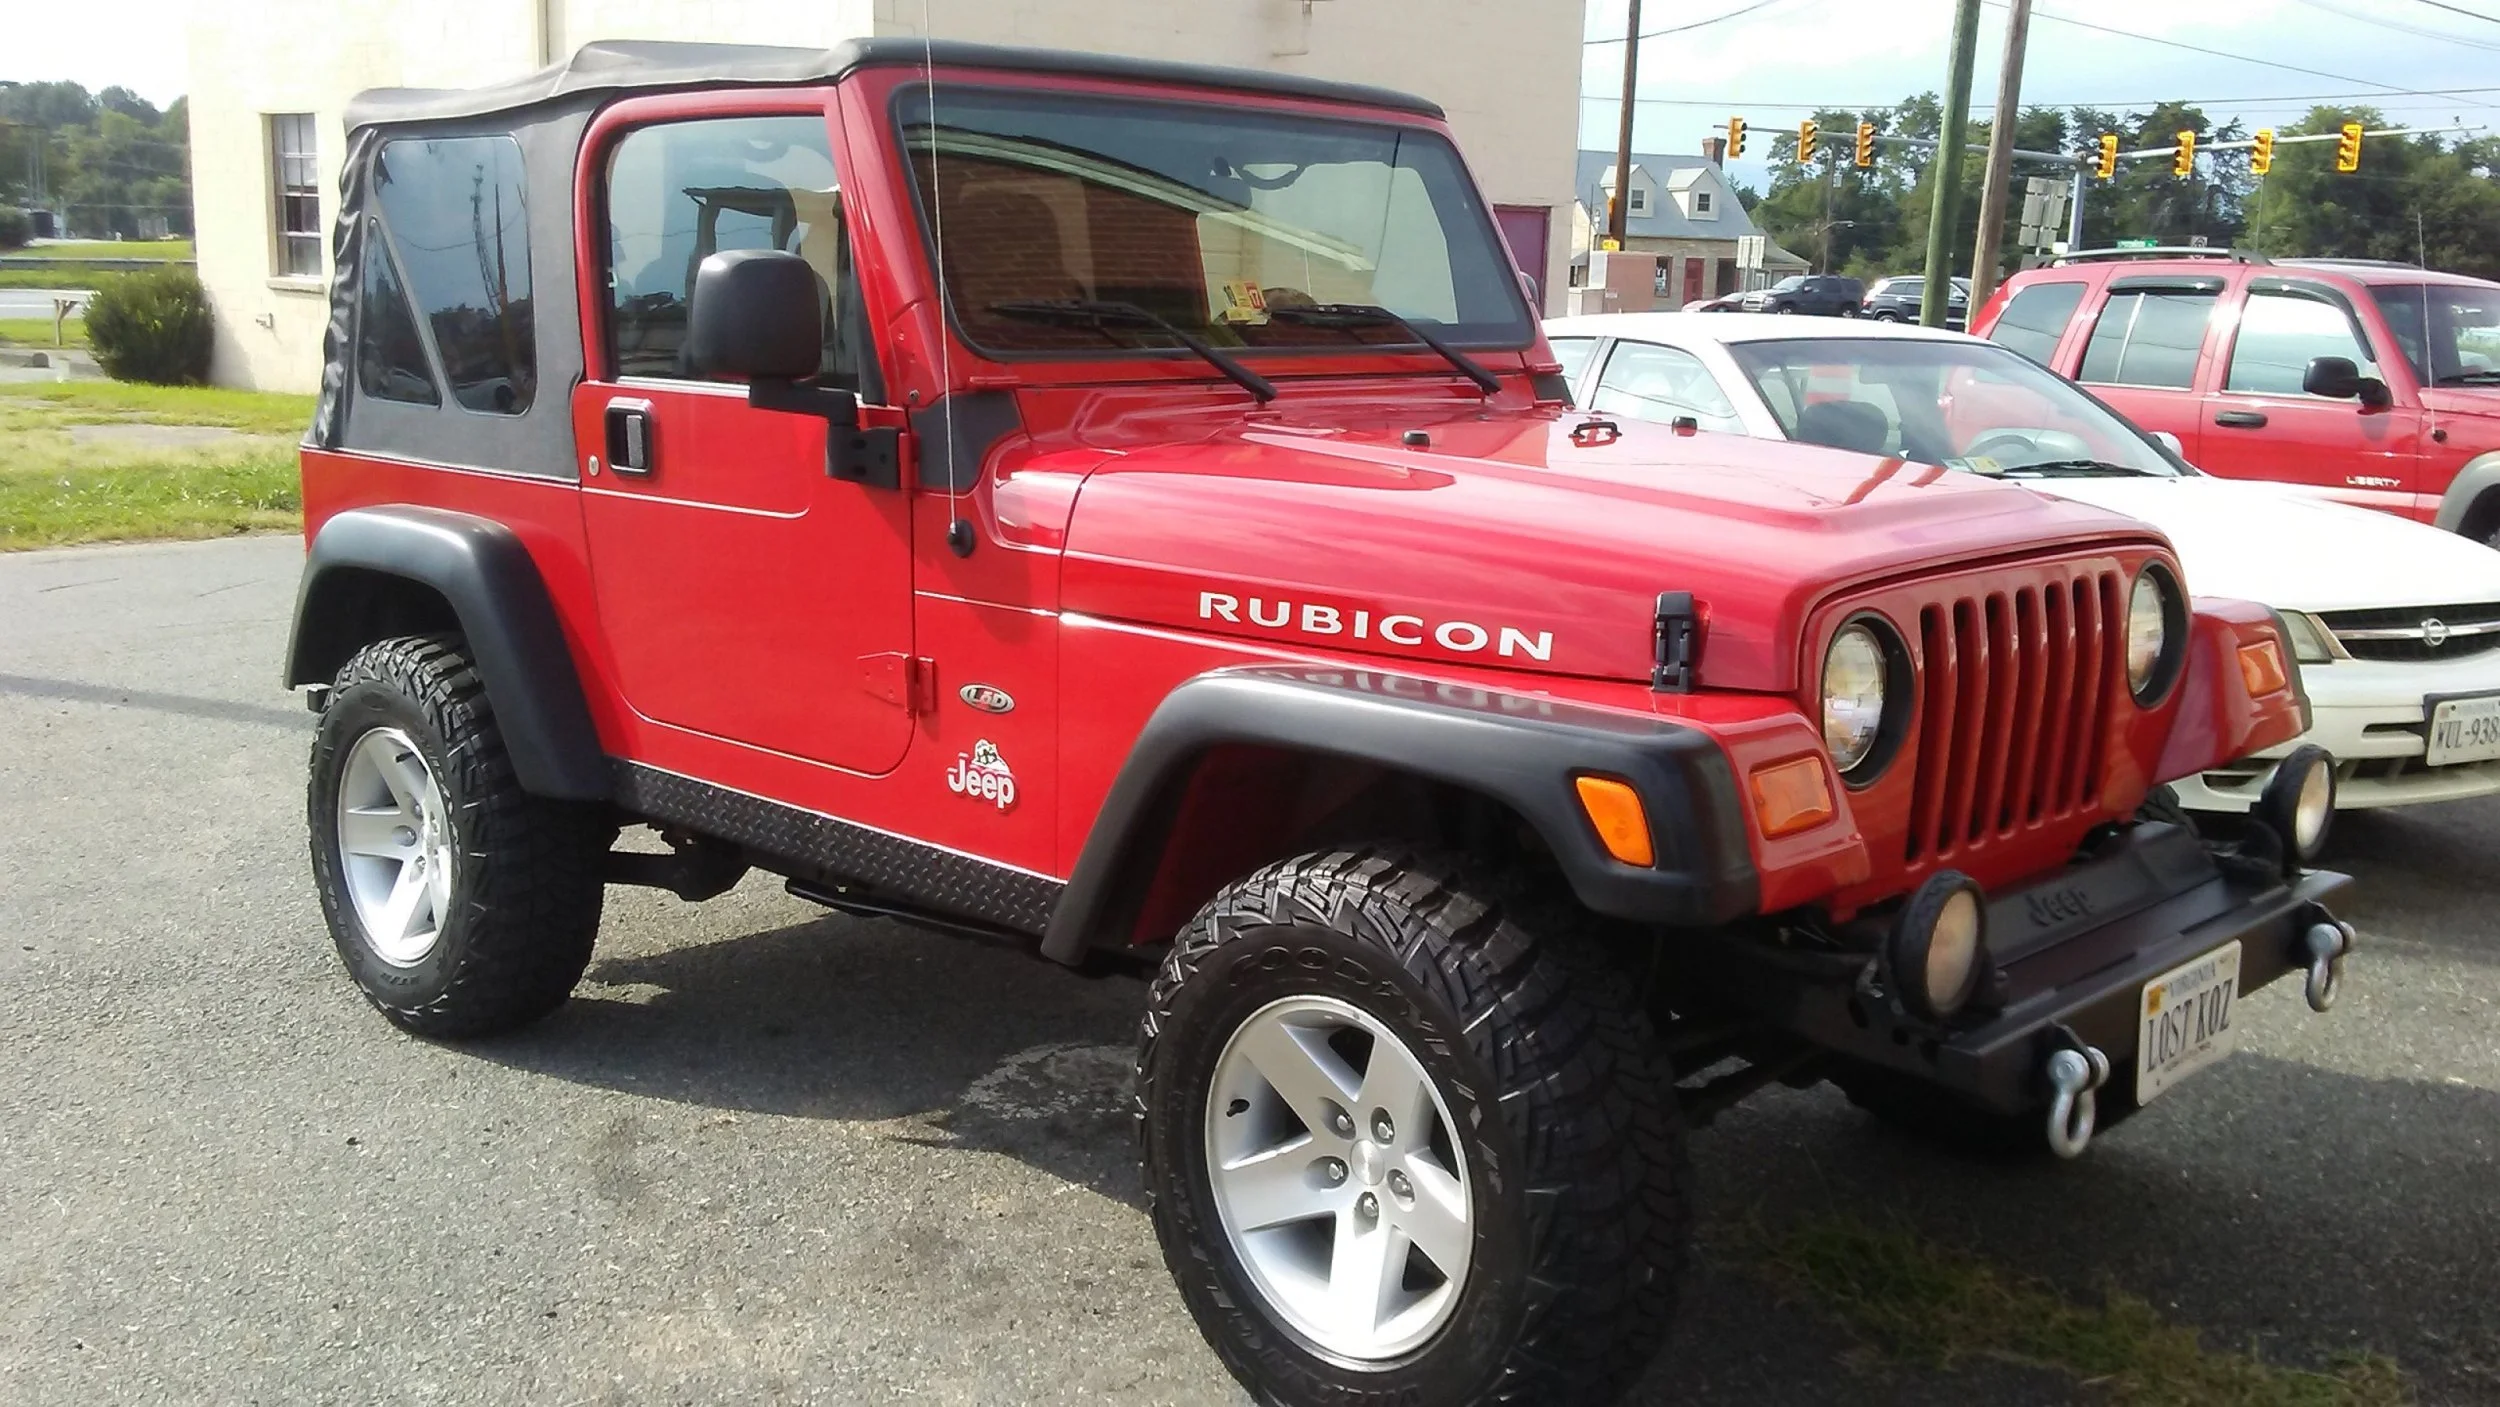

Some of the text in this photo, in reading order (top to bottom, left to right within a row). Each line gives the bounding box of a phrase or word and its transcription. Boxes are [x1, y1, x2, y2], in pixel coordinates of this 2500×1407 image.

[2346, 475, 2401, 487] LIBERTY
[1199, 591, 1553, 661] RUBICON
[947, 752, 1016, 809] Jeep
[2146, 998, 2193, 1073] LOST
[2195, 978, 2233, 1044] KOZ
